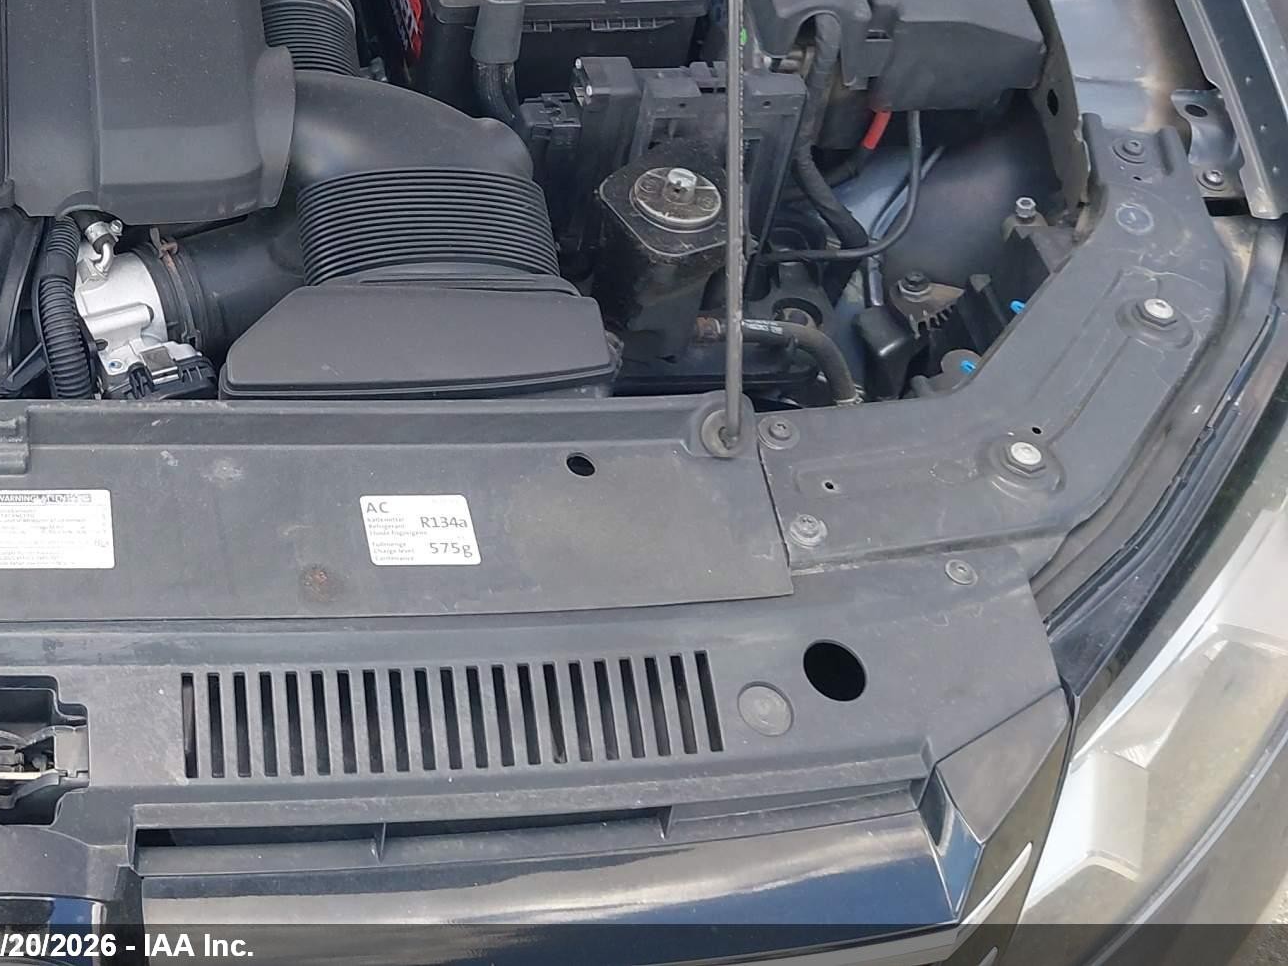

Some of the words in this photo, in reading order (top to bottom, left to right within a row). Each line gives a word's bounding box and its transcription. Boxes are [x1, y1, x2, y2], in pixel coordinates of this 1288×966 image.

[366, 501, 390, 514] AC
[419, 516, 468, 529] R134a
[429, 542, 473, 558] 575g
